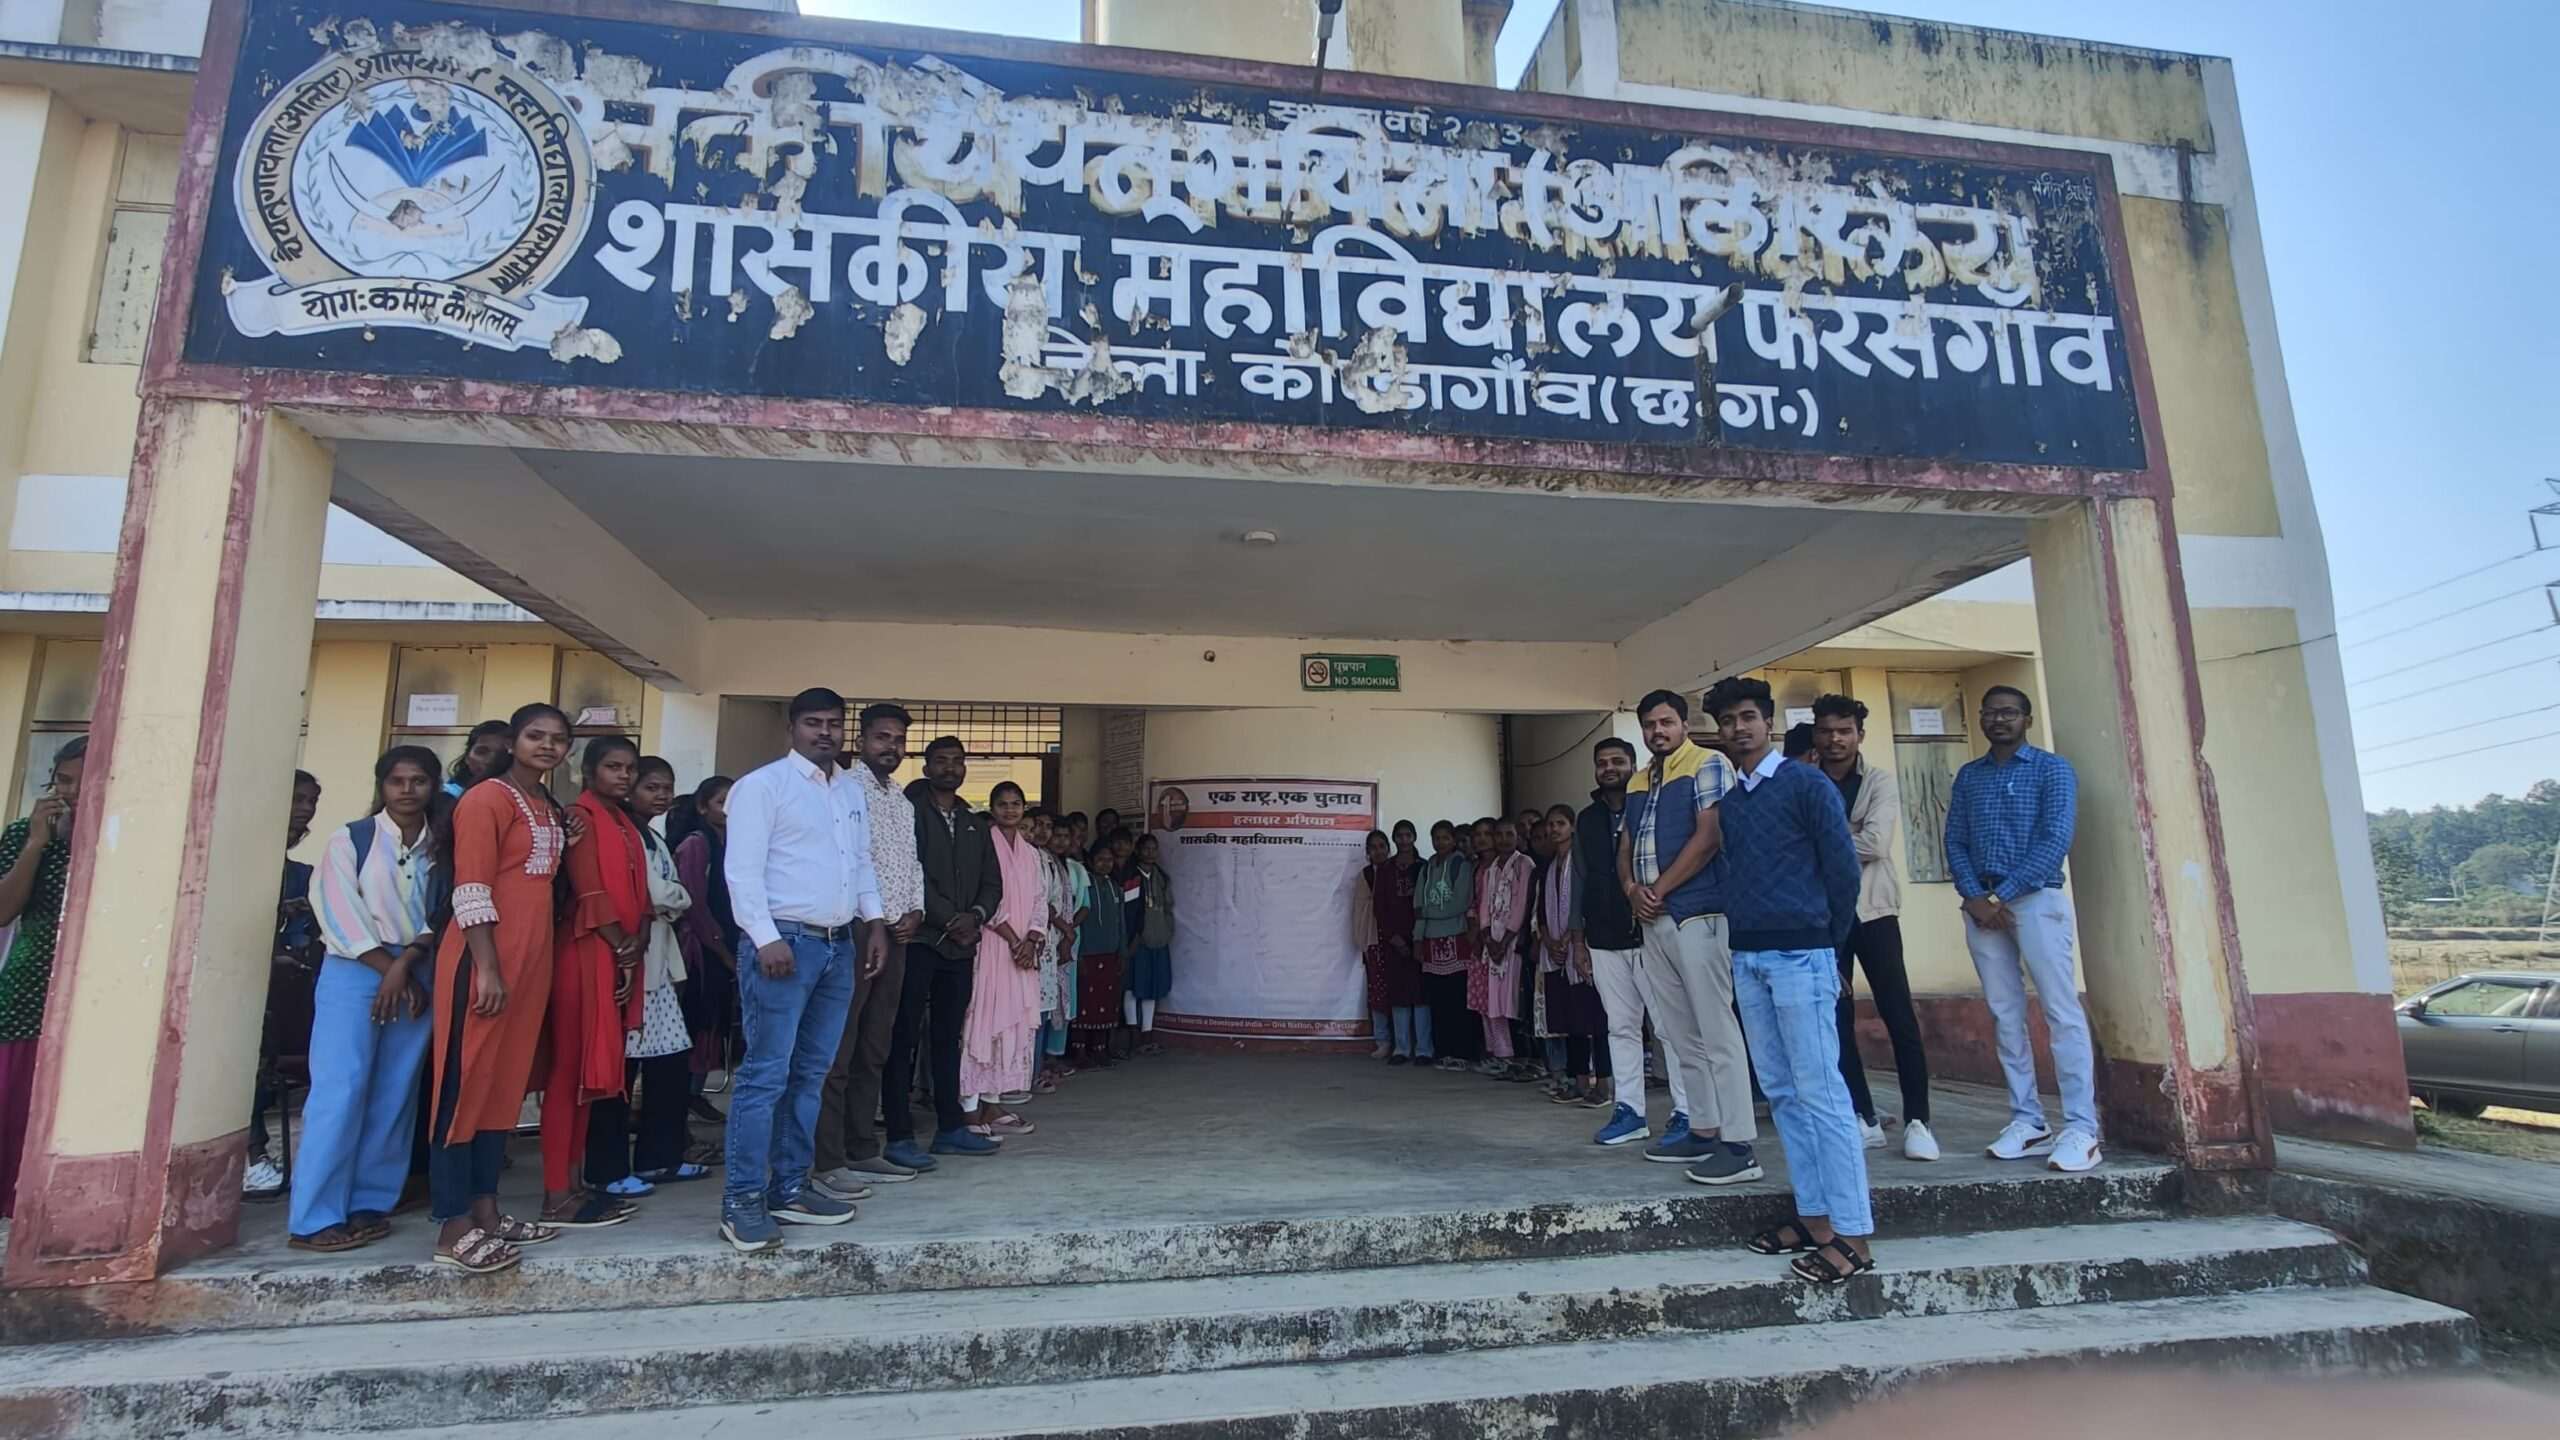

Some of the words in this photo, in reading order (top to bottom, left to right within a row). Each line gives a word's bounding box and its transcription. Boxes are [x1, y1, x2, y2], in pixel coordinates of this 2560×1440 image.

[595, 188, 1081, 319] शासकीय
[1111, 224, 1721, 363] महाविद्यालय
[1334, 677, 1349, 686] NO
[1351, 677, 1396, 686] SMOKING
[1208, 791, 1237, 805] एक
[1313, 792, 1363, 808] चुनाव
[1284, 812, 1336, 827] अभियान
[1180, 833, 1227, 846] शासकीय
